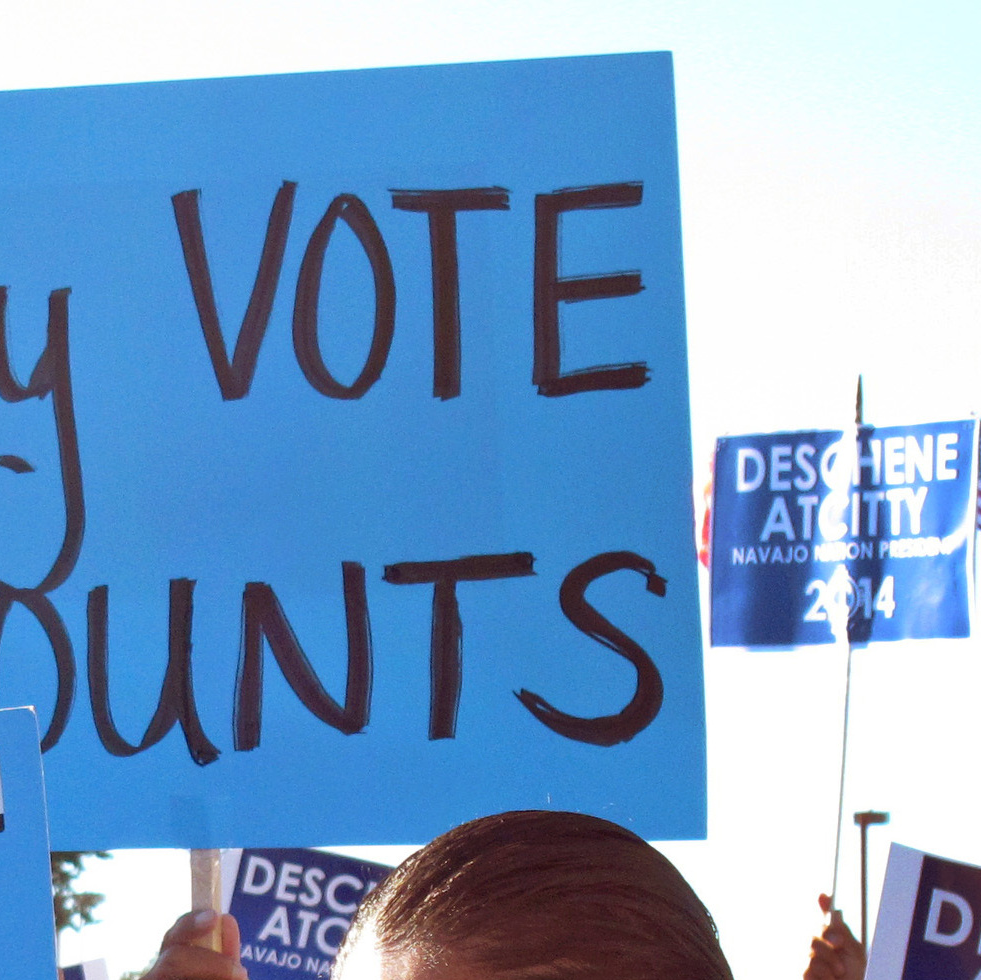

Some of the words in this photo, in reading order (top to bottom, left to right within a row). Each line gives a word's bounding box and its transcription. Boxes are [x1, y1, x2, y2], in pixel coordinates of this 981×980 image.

[170, 180, 653, 402] VOTE
[736, 432, 959, 494] DESCHENE
[759, 486, 928, 542] ATCITTY
[732, 545, 809, 566] NAVAJO
[242, 855, 377, 914] DESC
[239, 945, 302, 970] AVAJO
